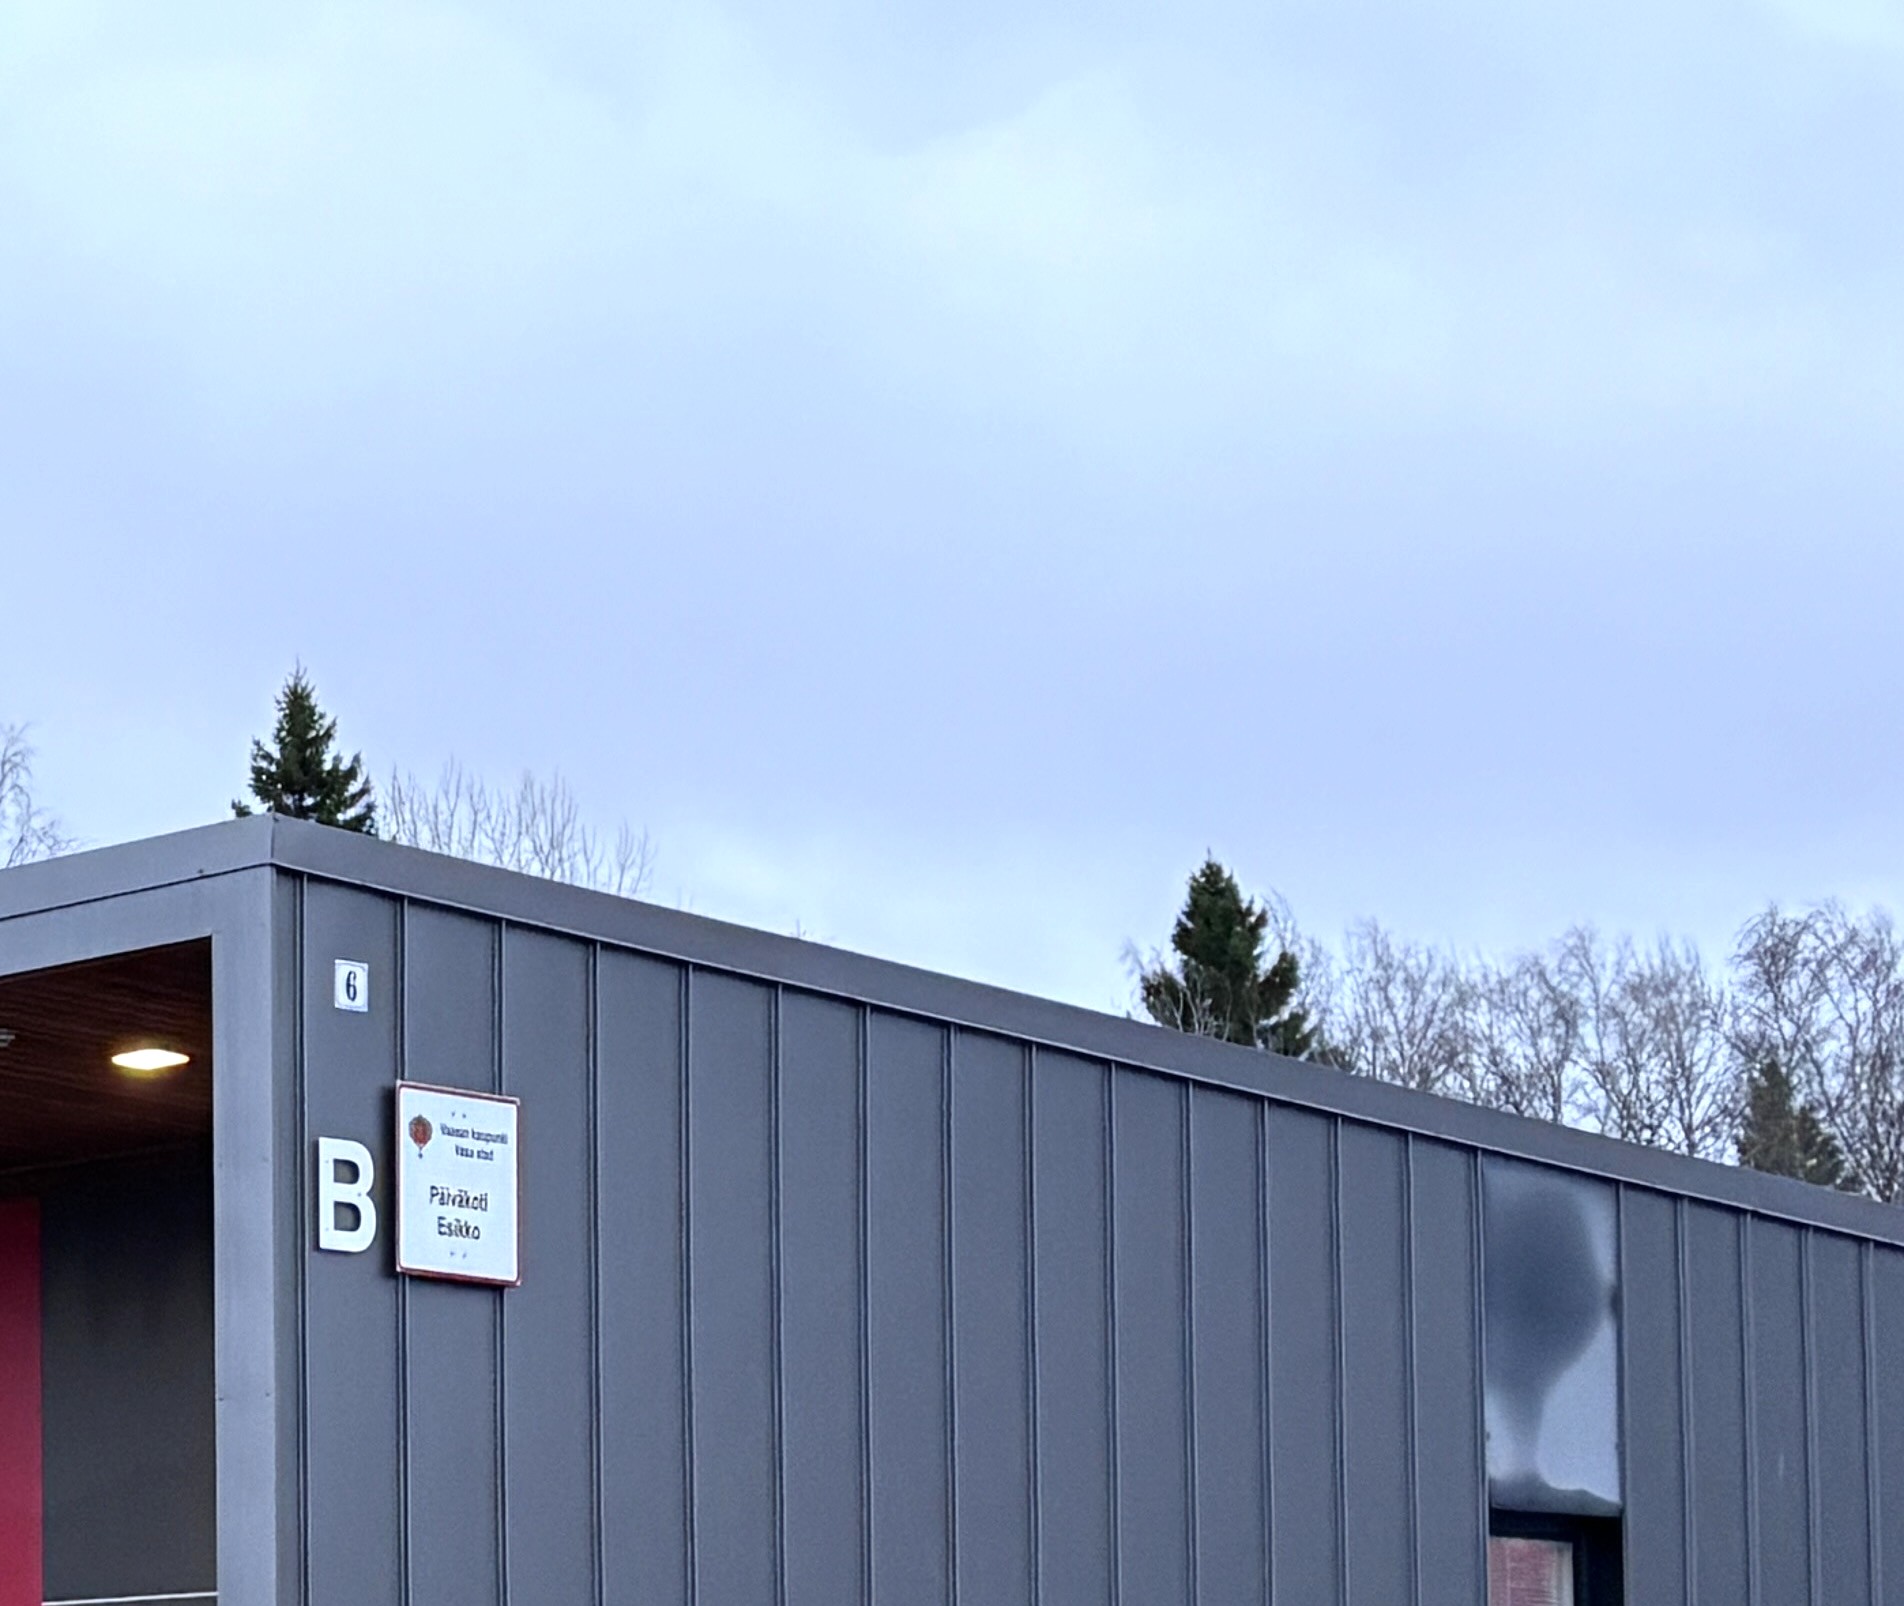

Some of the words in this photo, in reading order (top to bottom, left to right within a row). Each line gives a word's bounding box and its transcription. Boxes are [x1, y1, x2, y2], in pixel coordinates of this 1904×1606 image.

[346, 970, 357, 1002] 6
[318, 1137, 377, 1253] B
[429, 1185, 488, 1212] Päiväkoti
[437, 1216, 481, 1240] Esikko
